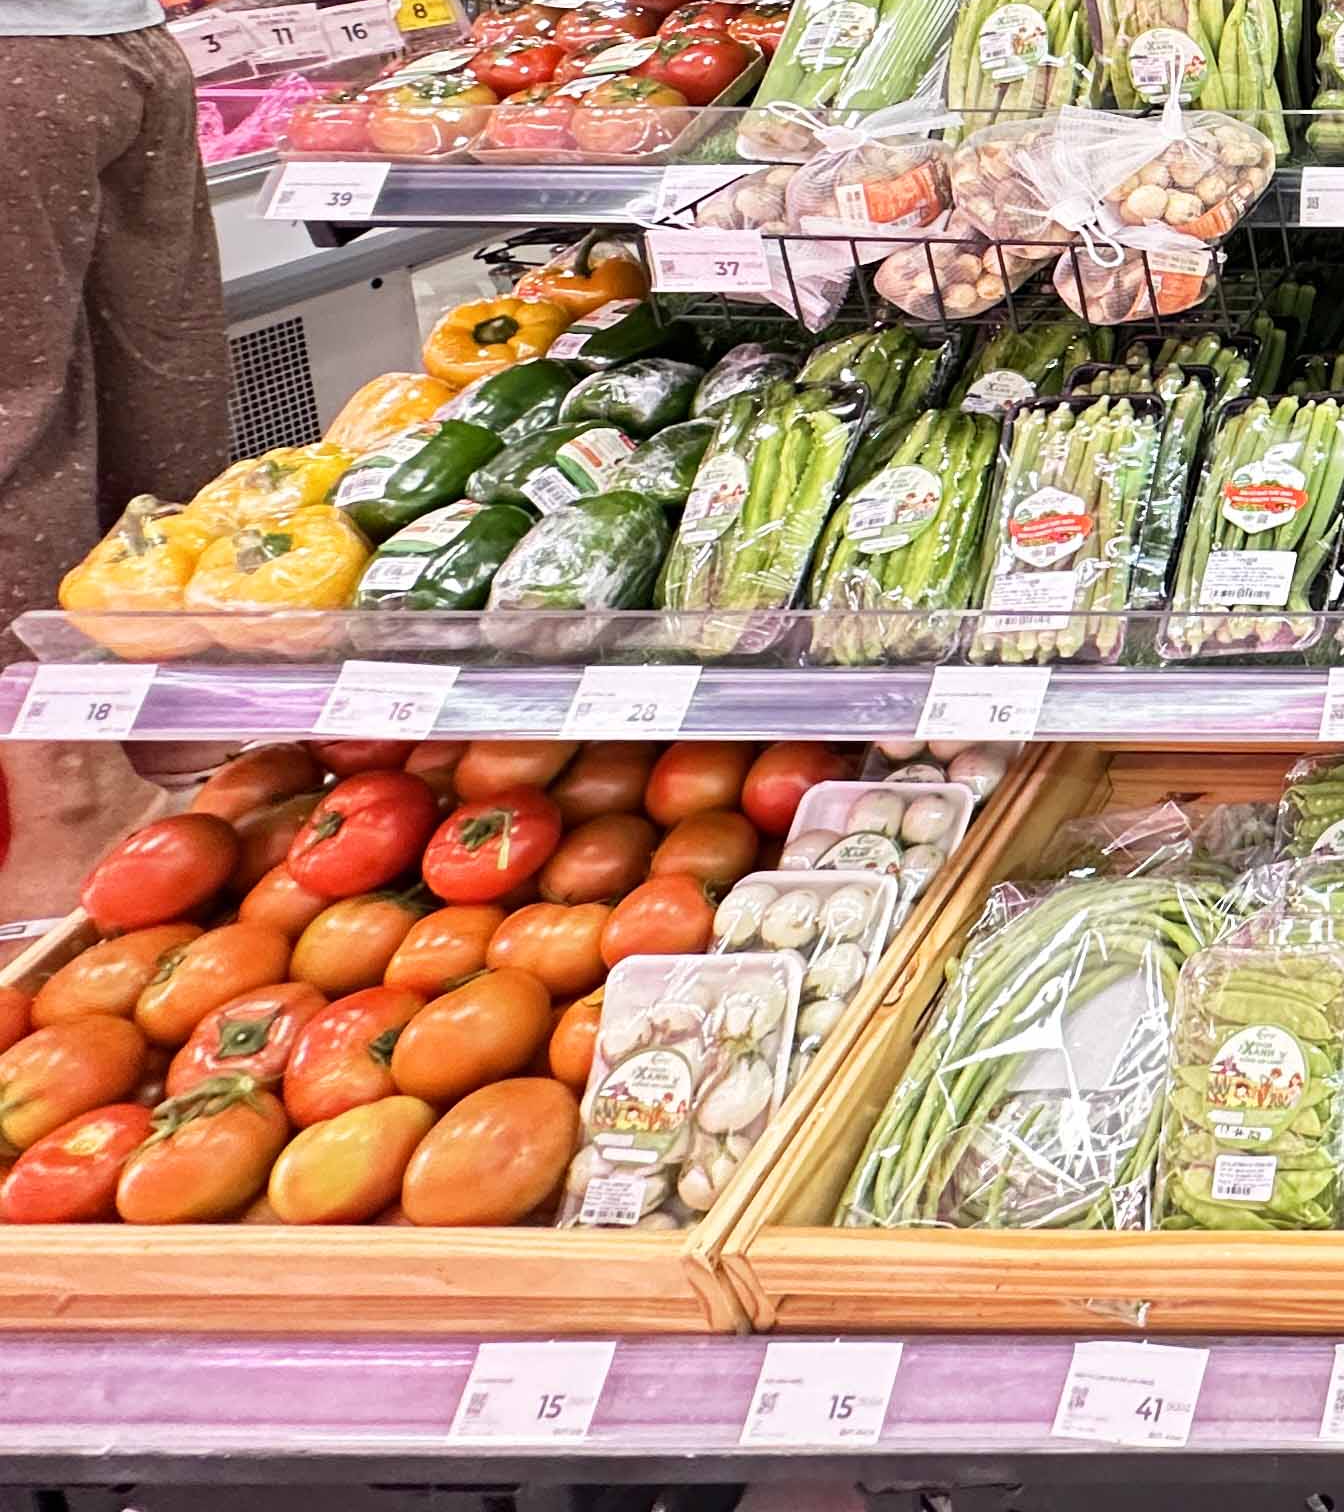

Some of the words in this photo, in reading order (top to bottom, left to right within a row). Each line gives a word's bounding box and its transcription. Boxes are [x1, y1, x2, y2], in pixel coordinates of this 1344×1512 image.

[412, 2, 428, 19] 8
[271, 27, 294, 45] 11
[340, 22, 369, 43] 16
[199, 33, 222, 54] 3
[325, 191, 353, 207] 39
[714, 261, 740, 277] 37
[87, 703, 113, 721] 18
[388, 701, 415, 721] 16
[625, 703, 658, 723] 28
[989, 704, 1013, 723] 16
[537, 1394, 566, 1420] 15
[828, 1395, 857, 1420] 15
[1135, 1396, 1164, 1423] 41
